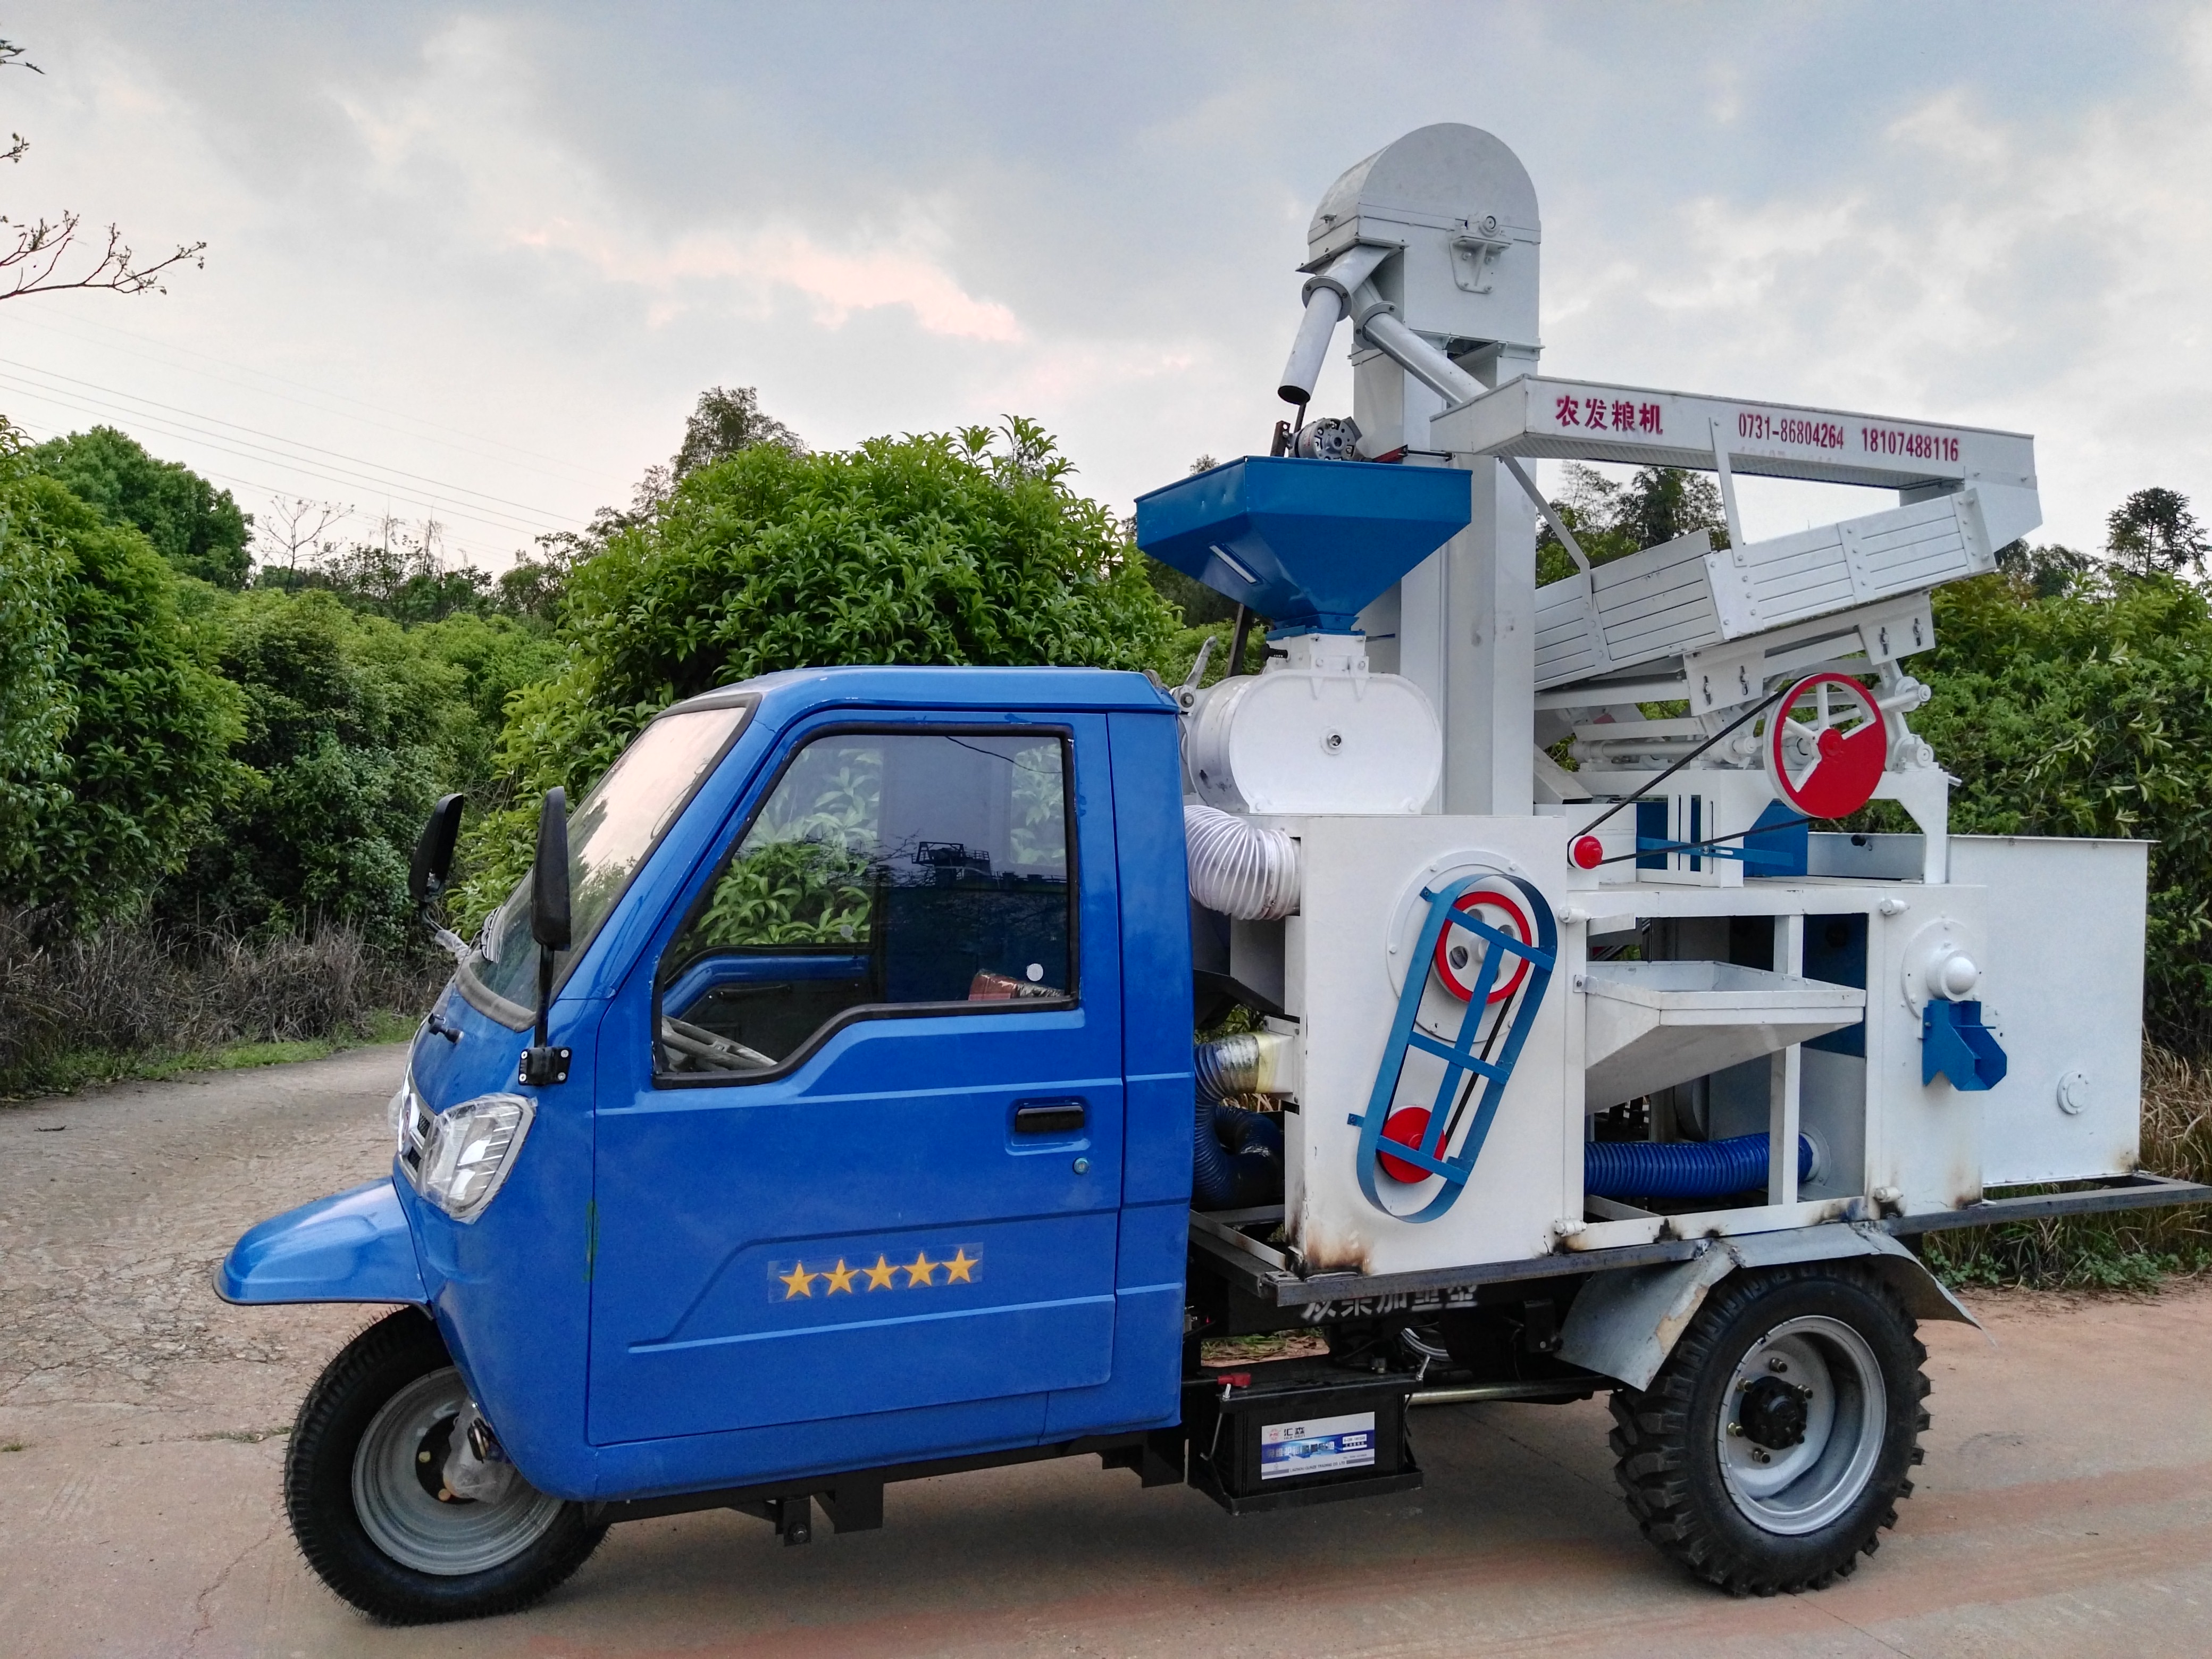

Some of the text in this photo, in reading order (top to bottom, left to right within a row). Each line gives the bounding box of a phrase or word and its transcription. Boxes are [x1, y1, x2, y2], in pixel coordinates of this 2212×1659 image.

[1555, 395, 1663, 435] 农发粮机
[1738, 413, 1844, 450] 0731-86804264
[1862, 427, 1959, 462] 18107488116
